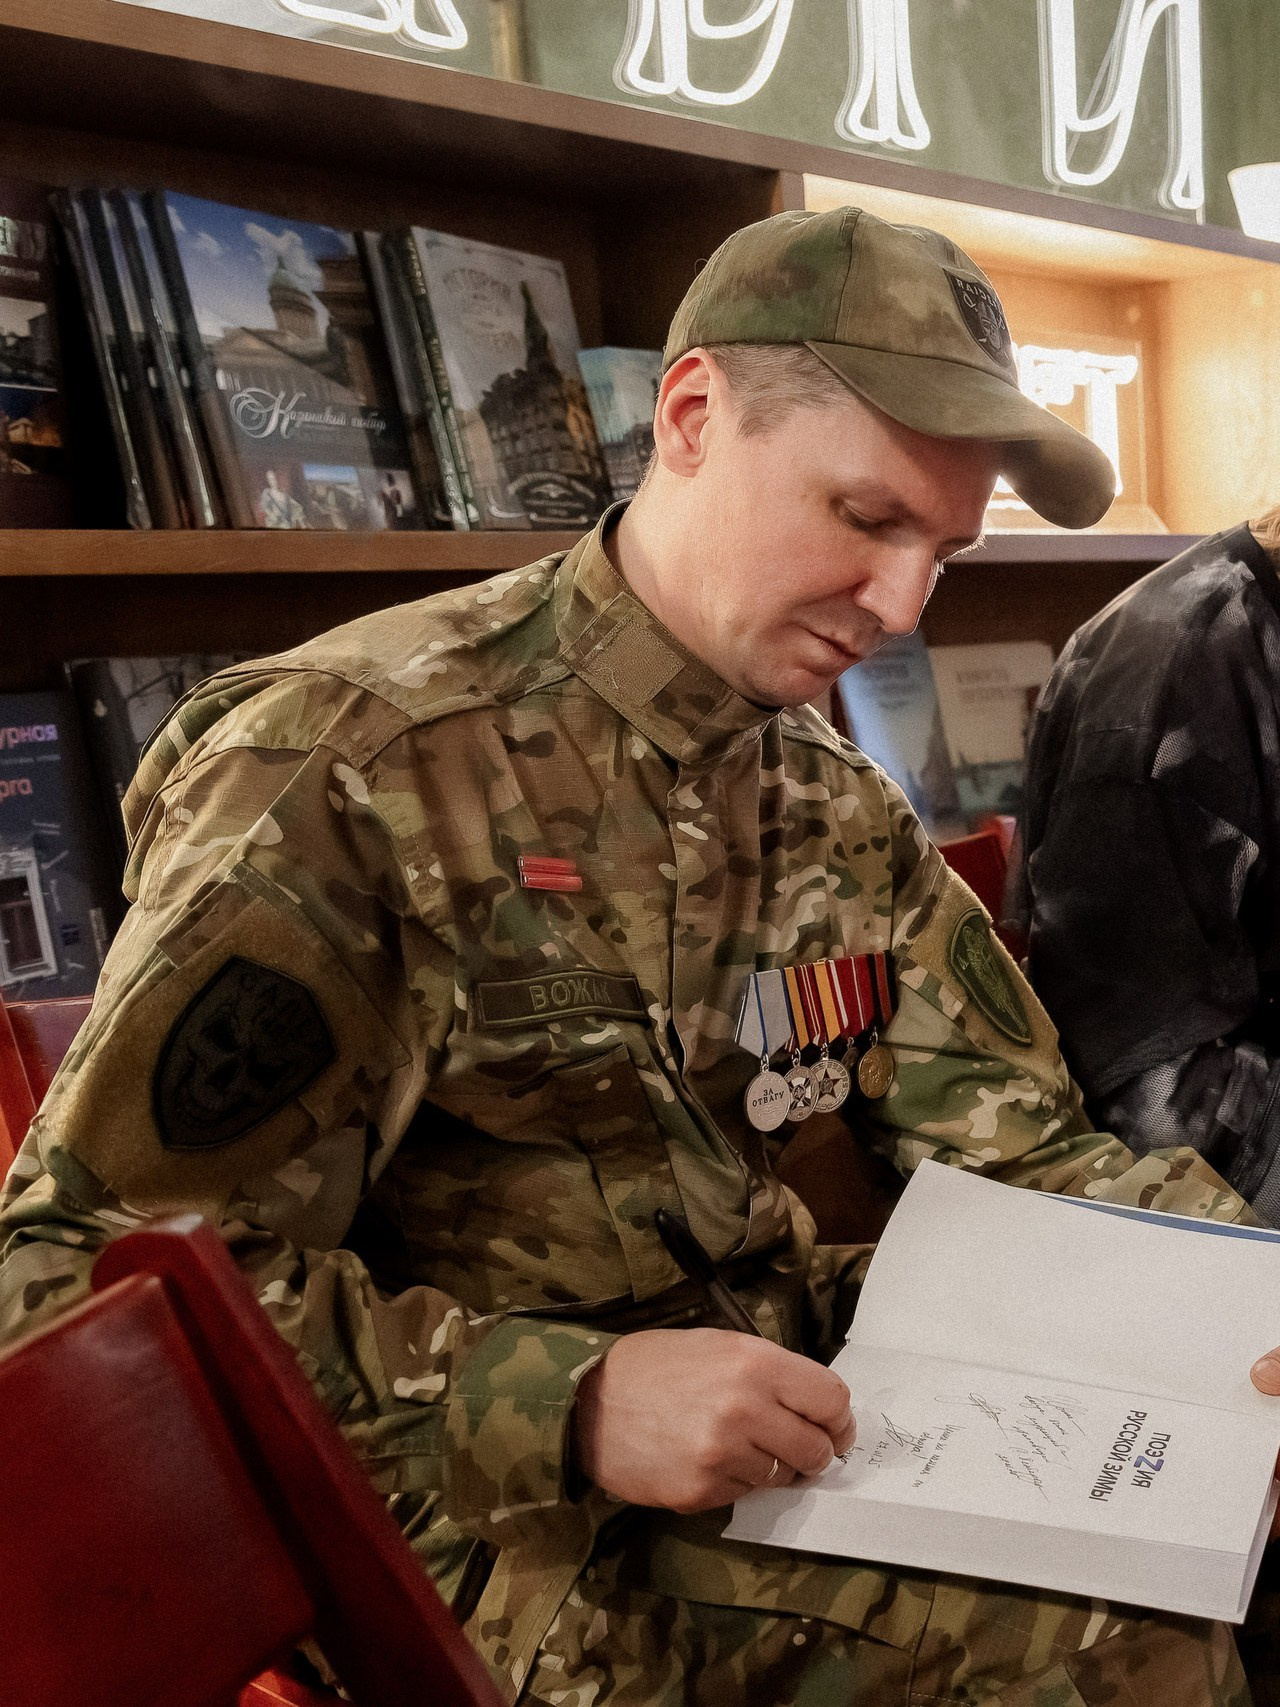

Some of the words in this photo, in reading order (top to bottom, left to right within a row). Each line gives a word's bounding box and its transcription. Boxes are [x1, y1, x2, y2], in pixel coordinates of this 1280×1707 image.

[752, 1091, 786, 1107] ОТВАГУ
[763, 1087, 775, 1096] ЗА
[1110, 1410, 1148, 1462] РУССКОЙ
[1131, 1432, 1171, 1489] ПОЭZИЯ
[1089, 1463, 1124, 1502] ЗИМЫ
